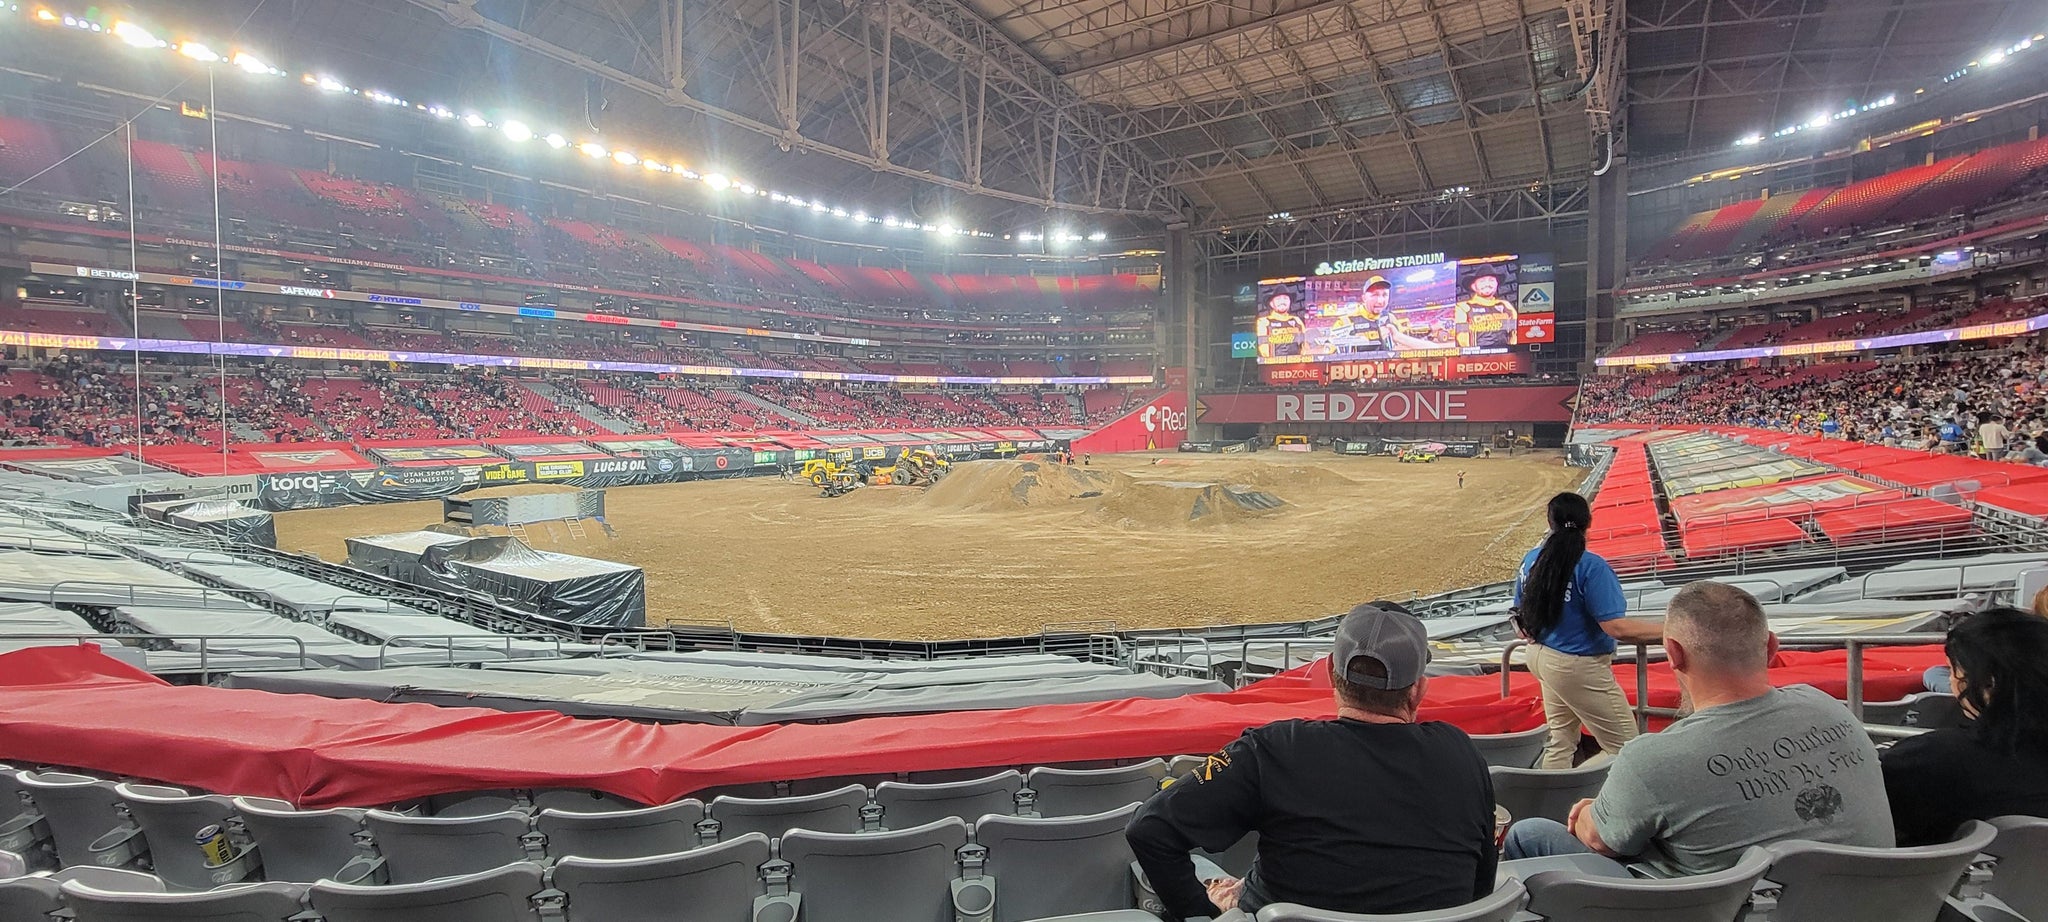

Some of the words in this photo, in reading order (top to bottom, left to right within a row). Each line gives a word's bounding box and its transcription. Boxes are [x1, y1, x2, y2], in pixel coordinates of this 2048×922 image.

[165, 237, 209, 248] CHARLES
[1395, 252, 1445, 267] STADIUM
[1856, 253, 1879, 261] GREEN
[329, 256, 363, 266] WILLIAM
[373, 262, 405, 271] BIDWILL
[90, 269, 140, 280] BETMGM
[280, 285, 324, 298] SAFEWAY
[383, 296, 422, 305] HYUNDAI
[459, 302, 481, 311] COX
[28, 334, 99, 349] ENGLAND
[1233, 341, 1257, 350] COX
[339, 348, 390, 361] ENGLAND
[1330, 363, 1375, 380] BUD
[1456, 361, 1517, 373] REDZONE
[1271, 368, 1319, 379] REDZONE
[1277, 391, 1467, 421] REDZONE
[1162, 406, 1187, 431] Red
[754, 451, 777, 464] BKT
[794, 450, 816, 462] BKT
[865, 448, 884, 459] JCB
[593, 461, 628, 473] LUCAS
[629, 459, 647, 471] OIL
[426, 469, 455, 477] SPORTS
[485, 470, 506, 480] VIDEO
[507, 469, 527, 479] GAME
[403, 476, 456, 484] COMMISSION
[1707, 747, 1770, 777] Only
[1773, 720, 1853, 760] Outlaws
[1736, 769, 1791, 801] Will
[1789, 761, 1824, 784] Be
[1827, 748, 1865, 775] Free
